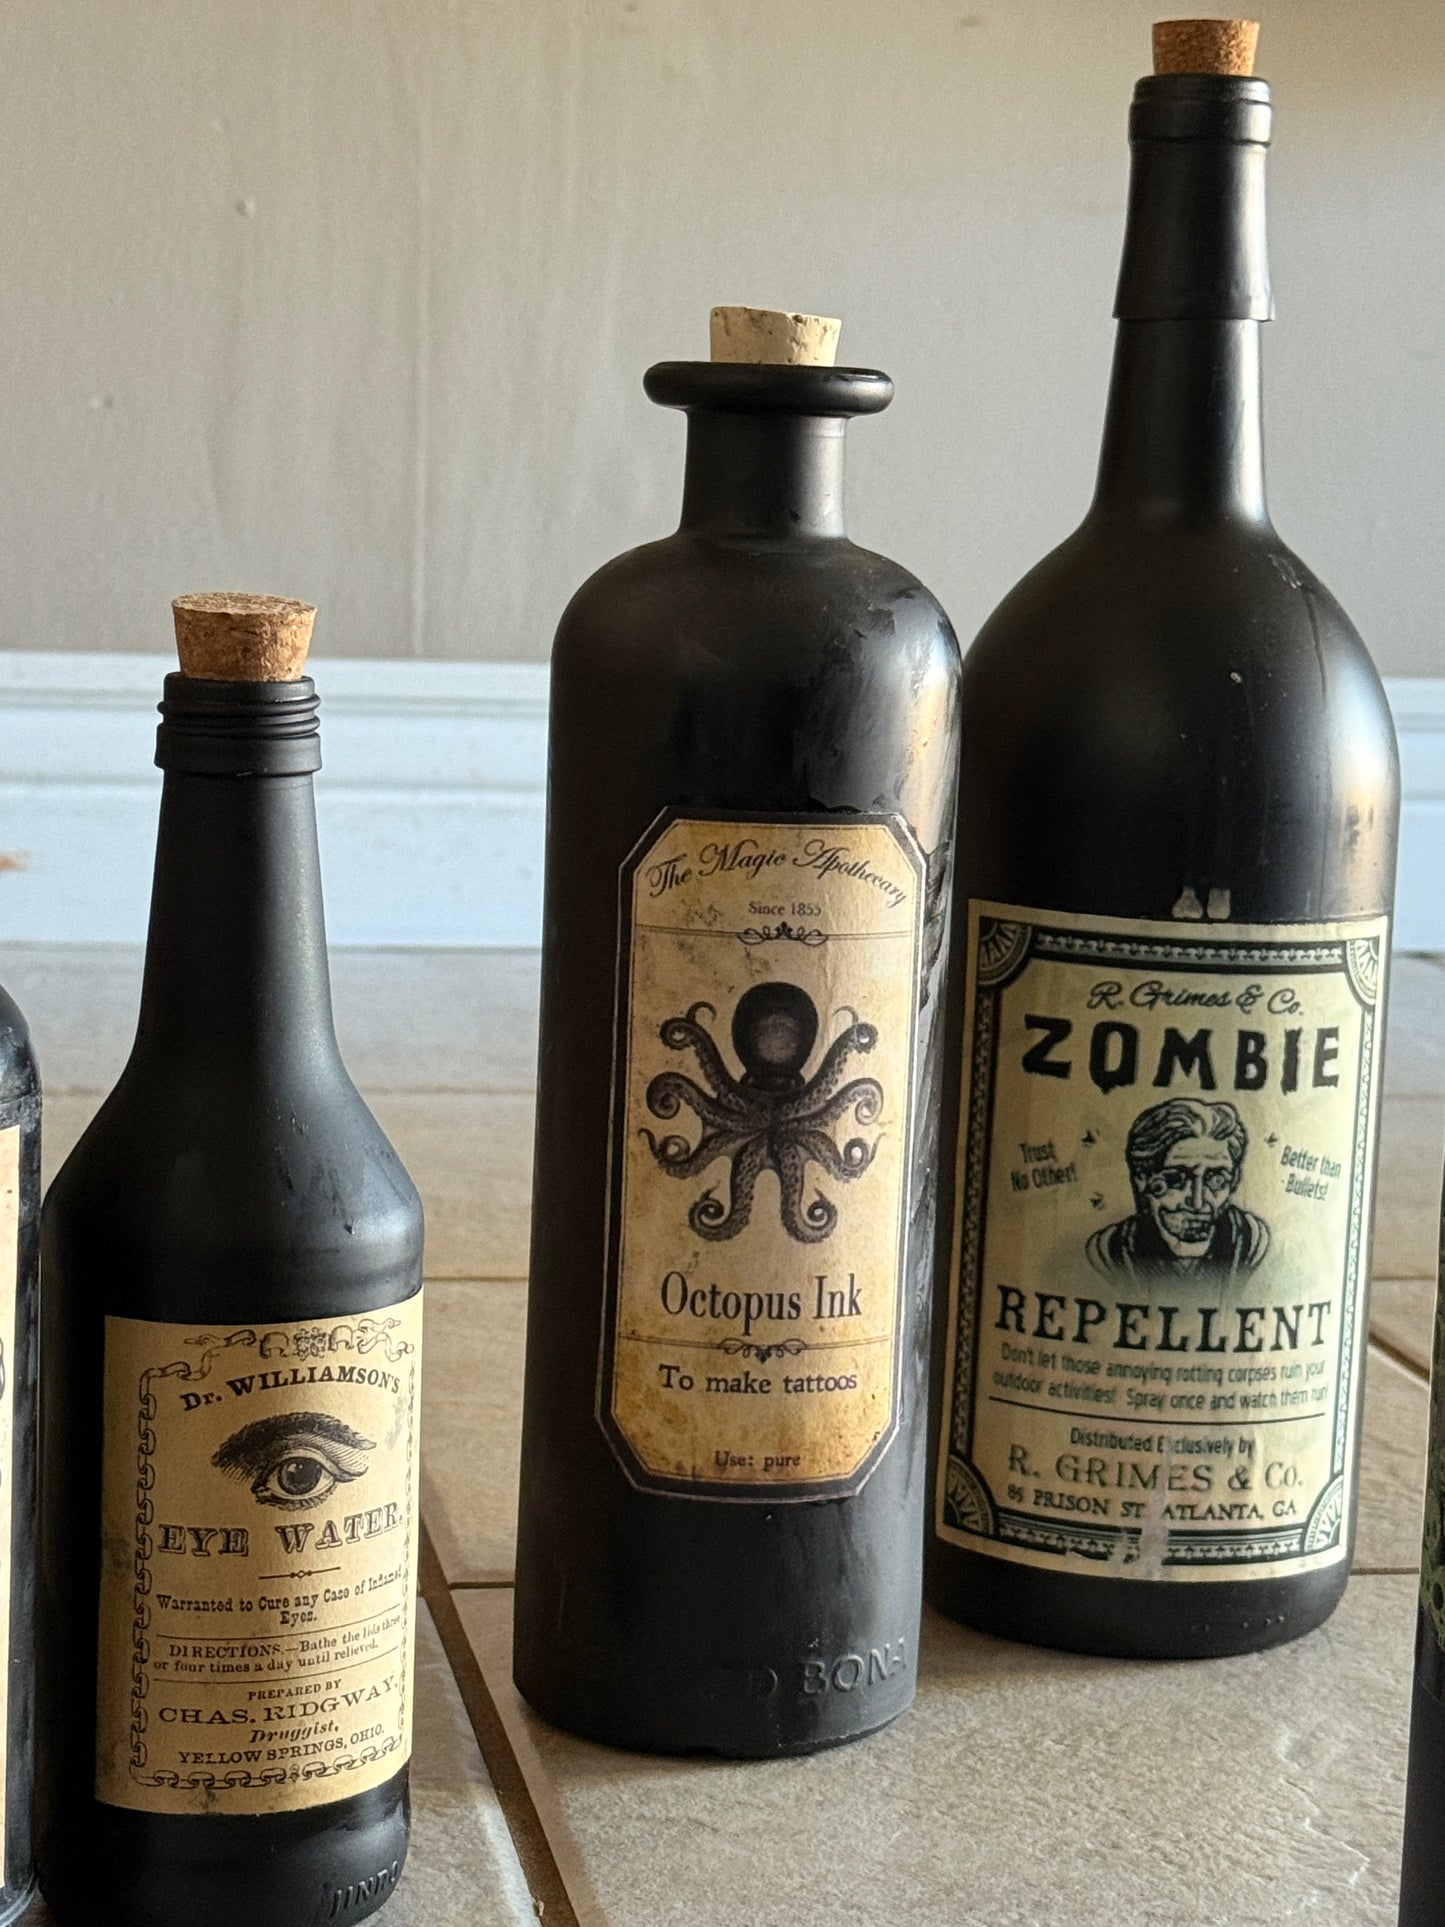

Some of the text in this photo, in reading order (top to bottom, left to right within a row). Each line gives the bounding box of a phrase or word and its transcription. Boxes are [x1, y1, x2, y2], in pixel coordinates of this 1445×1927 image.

[646, 838, 907, 908] The Magic Apothecary
[748, 901, 785, 916] Since
[1129, 980, 1233, 1011] Grimes
[1235, 983, 1264, 1015] &
[1266, 987, 1304, 1016] Co.
[1021, 1013, 1340, 1096] ZOMBIE
[1018, 1140, 1057, 1163] Trust
[1280, 1144, 1342, 1178] Better than
[1010, 1162, 1078, 1191] No Other!
[1285, 1173, 1329, 1201] Bullets!
[660, 1270, 862, 1337] Octopus Ink
[994, 1284, 1332, 1353] REPELLENT
[658, 1363, 857, 1394] To make tattoos
[1001, 1342, 1326, 1387] Don't let those annoying rotting corpses ruin your
[180, 1365, 401, 1411] Dr. WILLIAMSON'S
[992, 1371, 1043, 1393] outdoor
[1126, 1387, 1166, 1411] Spray
[1170, 1393, 1205, 1410] once
[1209, 1391, 1236, 1411] and
[1239, 1390, 1277, 1409] watch
[1280, 1388, 1308, 1407] them
[1070, 1427, 1254, 1459] Distributed Eclusively by
[713, 1450, 801, 1472] Use: pure
[1008, 1444, 1040, 1477] R.
[1055, 1453, 1214, 1492] GRIMES
[1227, 1464, 1253, 1491] &
[1007, 1484, 1024, 1500] 85
[1034, 1488, 1109, 1516] PRISON
[1162, 1503, 1264, 1521] ATLANTA,
[1272, 1500, 1297, 1517] GA
[159, 1524, 249, 1557] EYE
[156, 1594, 233, 1612] Warranted
[240, 1599, 253, 1612] to
[258, 1596, 289, 1611] Cure
[294, 1593, 319, 1608] any
[323, 1588, 349, 1603] Case
[355, 1580, 366, 1595] of
[280, 1610, 318, 1628] Eyes.
[342, 1630, 360, 1645] the
[363, 1624, 381, 1639] lids
[153, 1638, 378, 1673] or four times a day until relieved.
[247, 1678, 342, 1701] PREPARED BY
[158, 1707, 256, 1725] CHAS.
[179, 1749, 262, 1764] YELLOW
[266, 1737, 348, 1761] SPRINGS,
